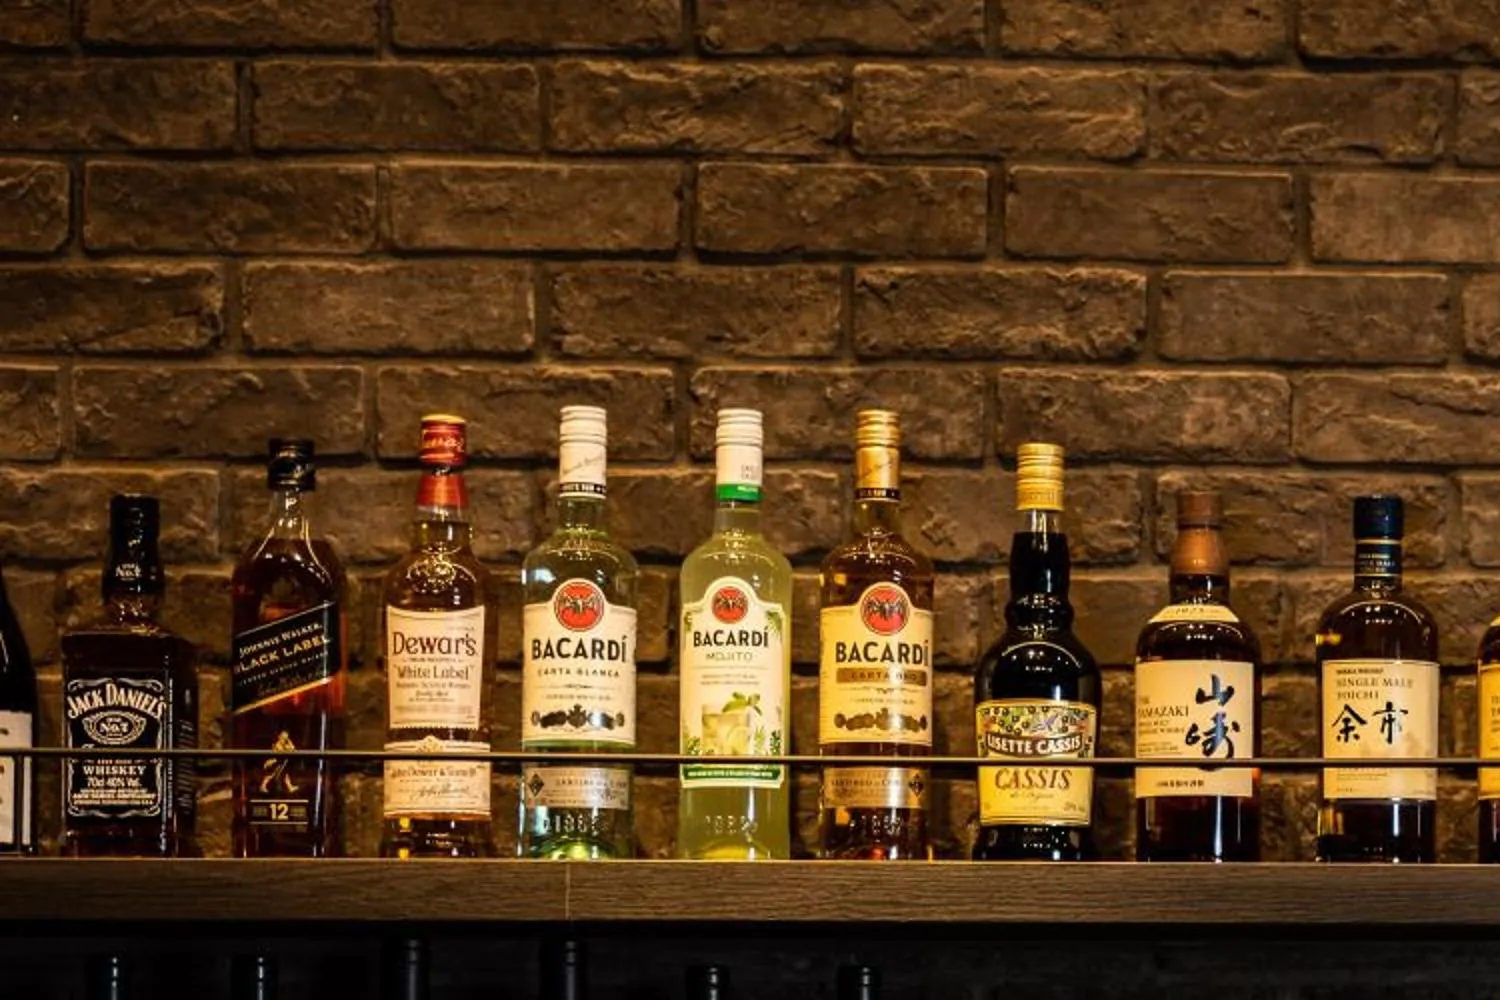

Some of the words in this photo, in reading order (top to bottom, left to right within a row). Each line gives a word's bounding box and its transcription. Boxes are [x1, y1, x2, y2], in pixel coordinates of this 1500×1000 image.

[393, 631, 478, 656] Dewar's
[531, 634, 627, 662] BACARDÍ
[693, 625, 769, 648] BACARDÍ
[67, 689, 104, 719] JACK
[106, 683, 168, 720] DANIEL'S
[1331, 700, 1409, 745] 余市
[83, 766, 147, 775] WHISKEY
[995, 767, 1073, 790] CASSIS
[269, 803, 289, 820] 12
